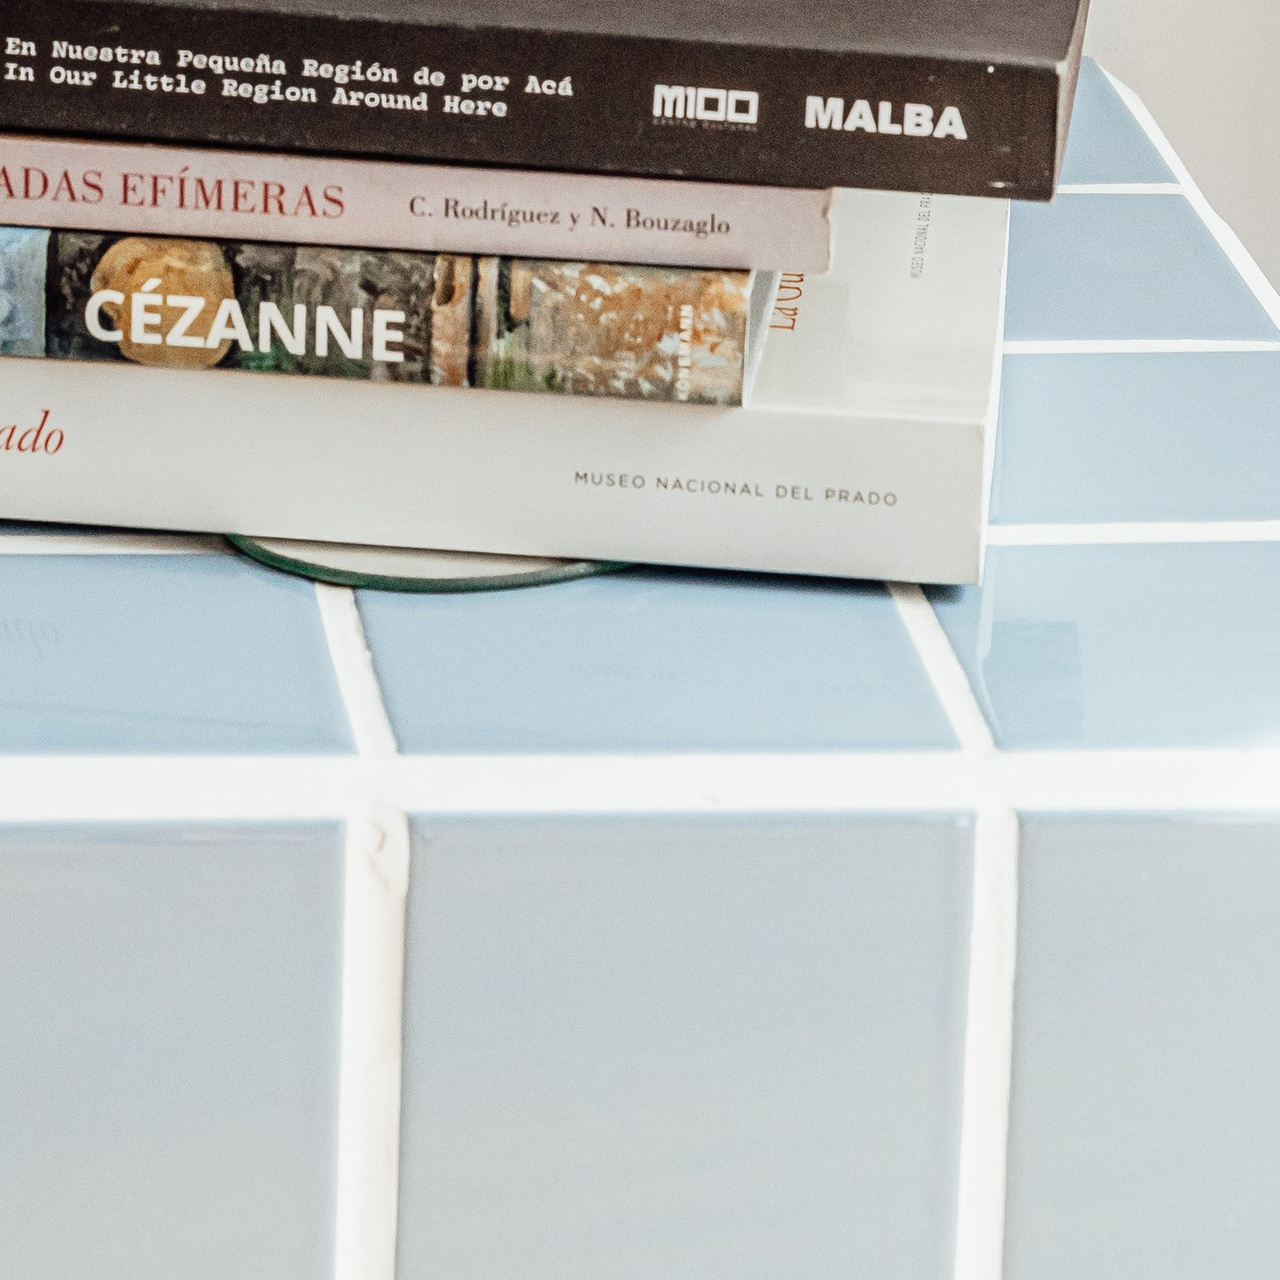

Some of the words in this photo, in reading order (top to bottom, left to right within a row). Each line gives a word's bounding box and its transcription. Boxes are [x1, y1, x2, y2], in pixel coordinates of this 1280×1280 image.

[4, 37, 38, 57] En
[51, 40, 161, 67] Nuestra
[176, 49, 287, 75] Pequeña
[302, 58, 399, 84] Región
[413, 66, 446, 87] de
[461, 72, 510, 93] por
[524, 75, 573, 97] Acá
[4, 62, 36, 82] In
[49, 66, 97, 86] Our
[111, 69, 207, 95] Little
[221, 78, 318, 104] Region
[332, 87, 429, 112] Around
[442, 95, 508, 118] Here
[805, 95, 968, 140] MALBA
[119, 167, 345, 218] EFÍMERAS
[409, 194, 433, 219] C.
[443, 196, 562, 228] Rodríguez
[569, 211, 581, 232] y
[590, 205, 616, 229] N.
[625, 207, 731, 238] Bouzaglo
[84, 278, 406, 364] CÉZANNE
[573, 470, 646, 489] MUSEO
[655, 476, 765, 498] NACIONAL
[774, 484, 813, 501] DEL
[824, 487, 898, 507] PRADO
